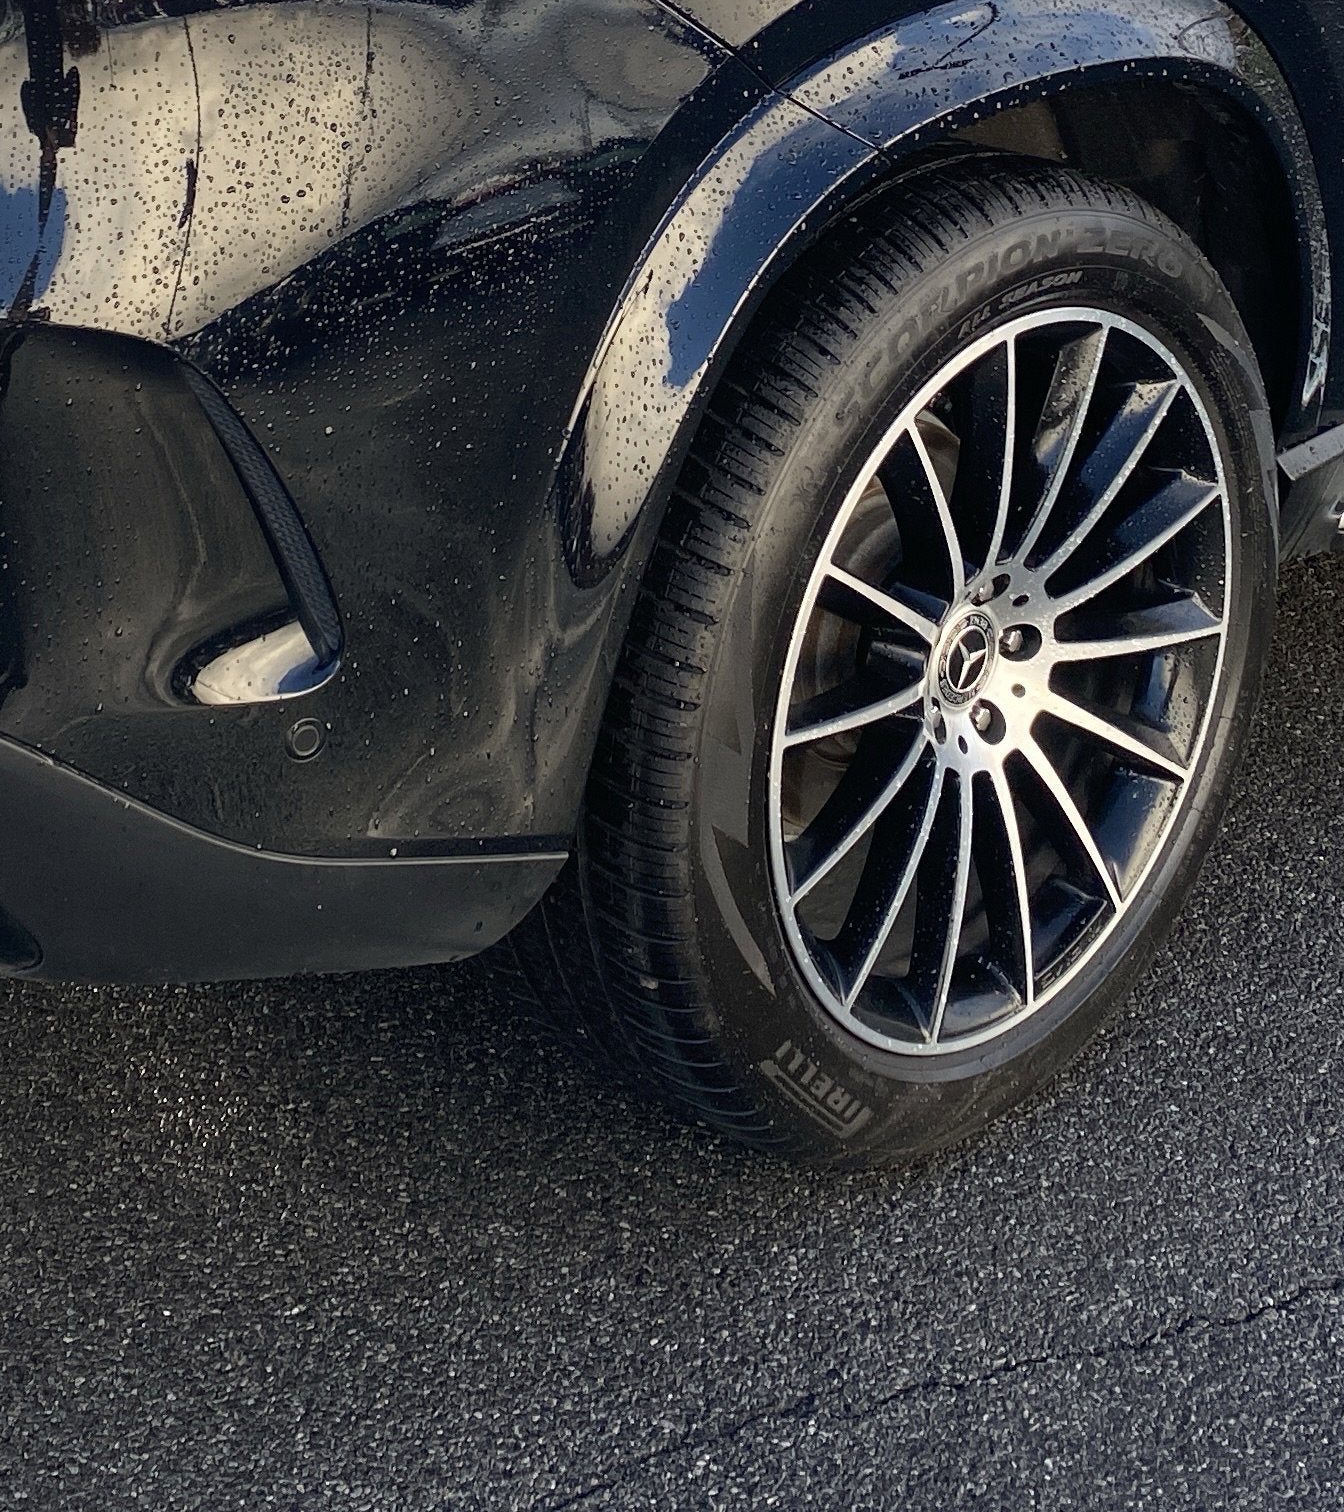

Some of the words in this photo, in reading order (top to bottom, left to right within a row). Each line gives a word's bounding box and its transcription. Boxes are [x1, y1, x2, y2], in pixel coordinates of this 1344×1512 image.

[1076, 227, 1184, 278] ZERO
[957, 307, 991, 339] ALL
[998, 270, 1084, 310] SEASON
[759, 1039, 874, 1139] PIRELLI
